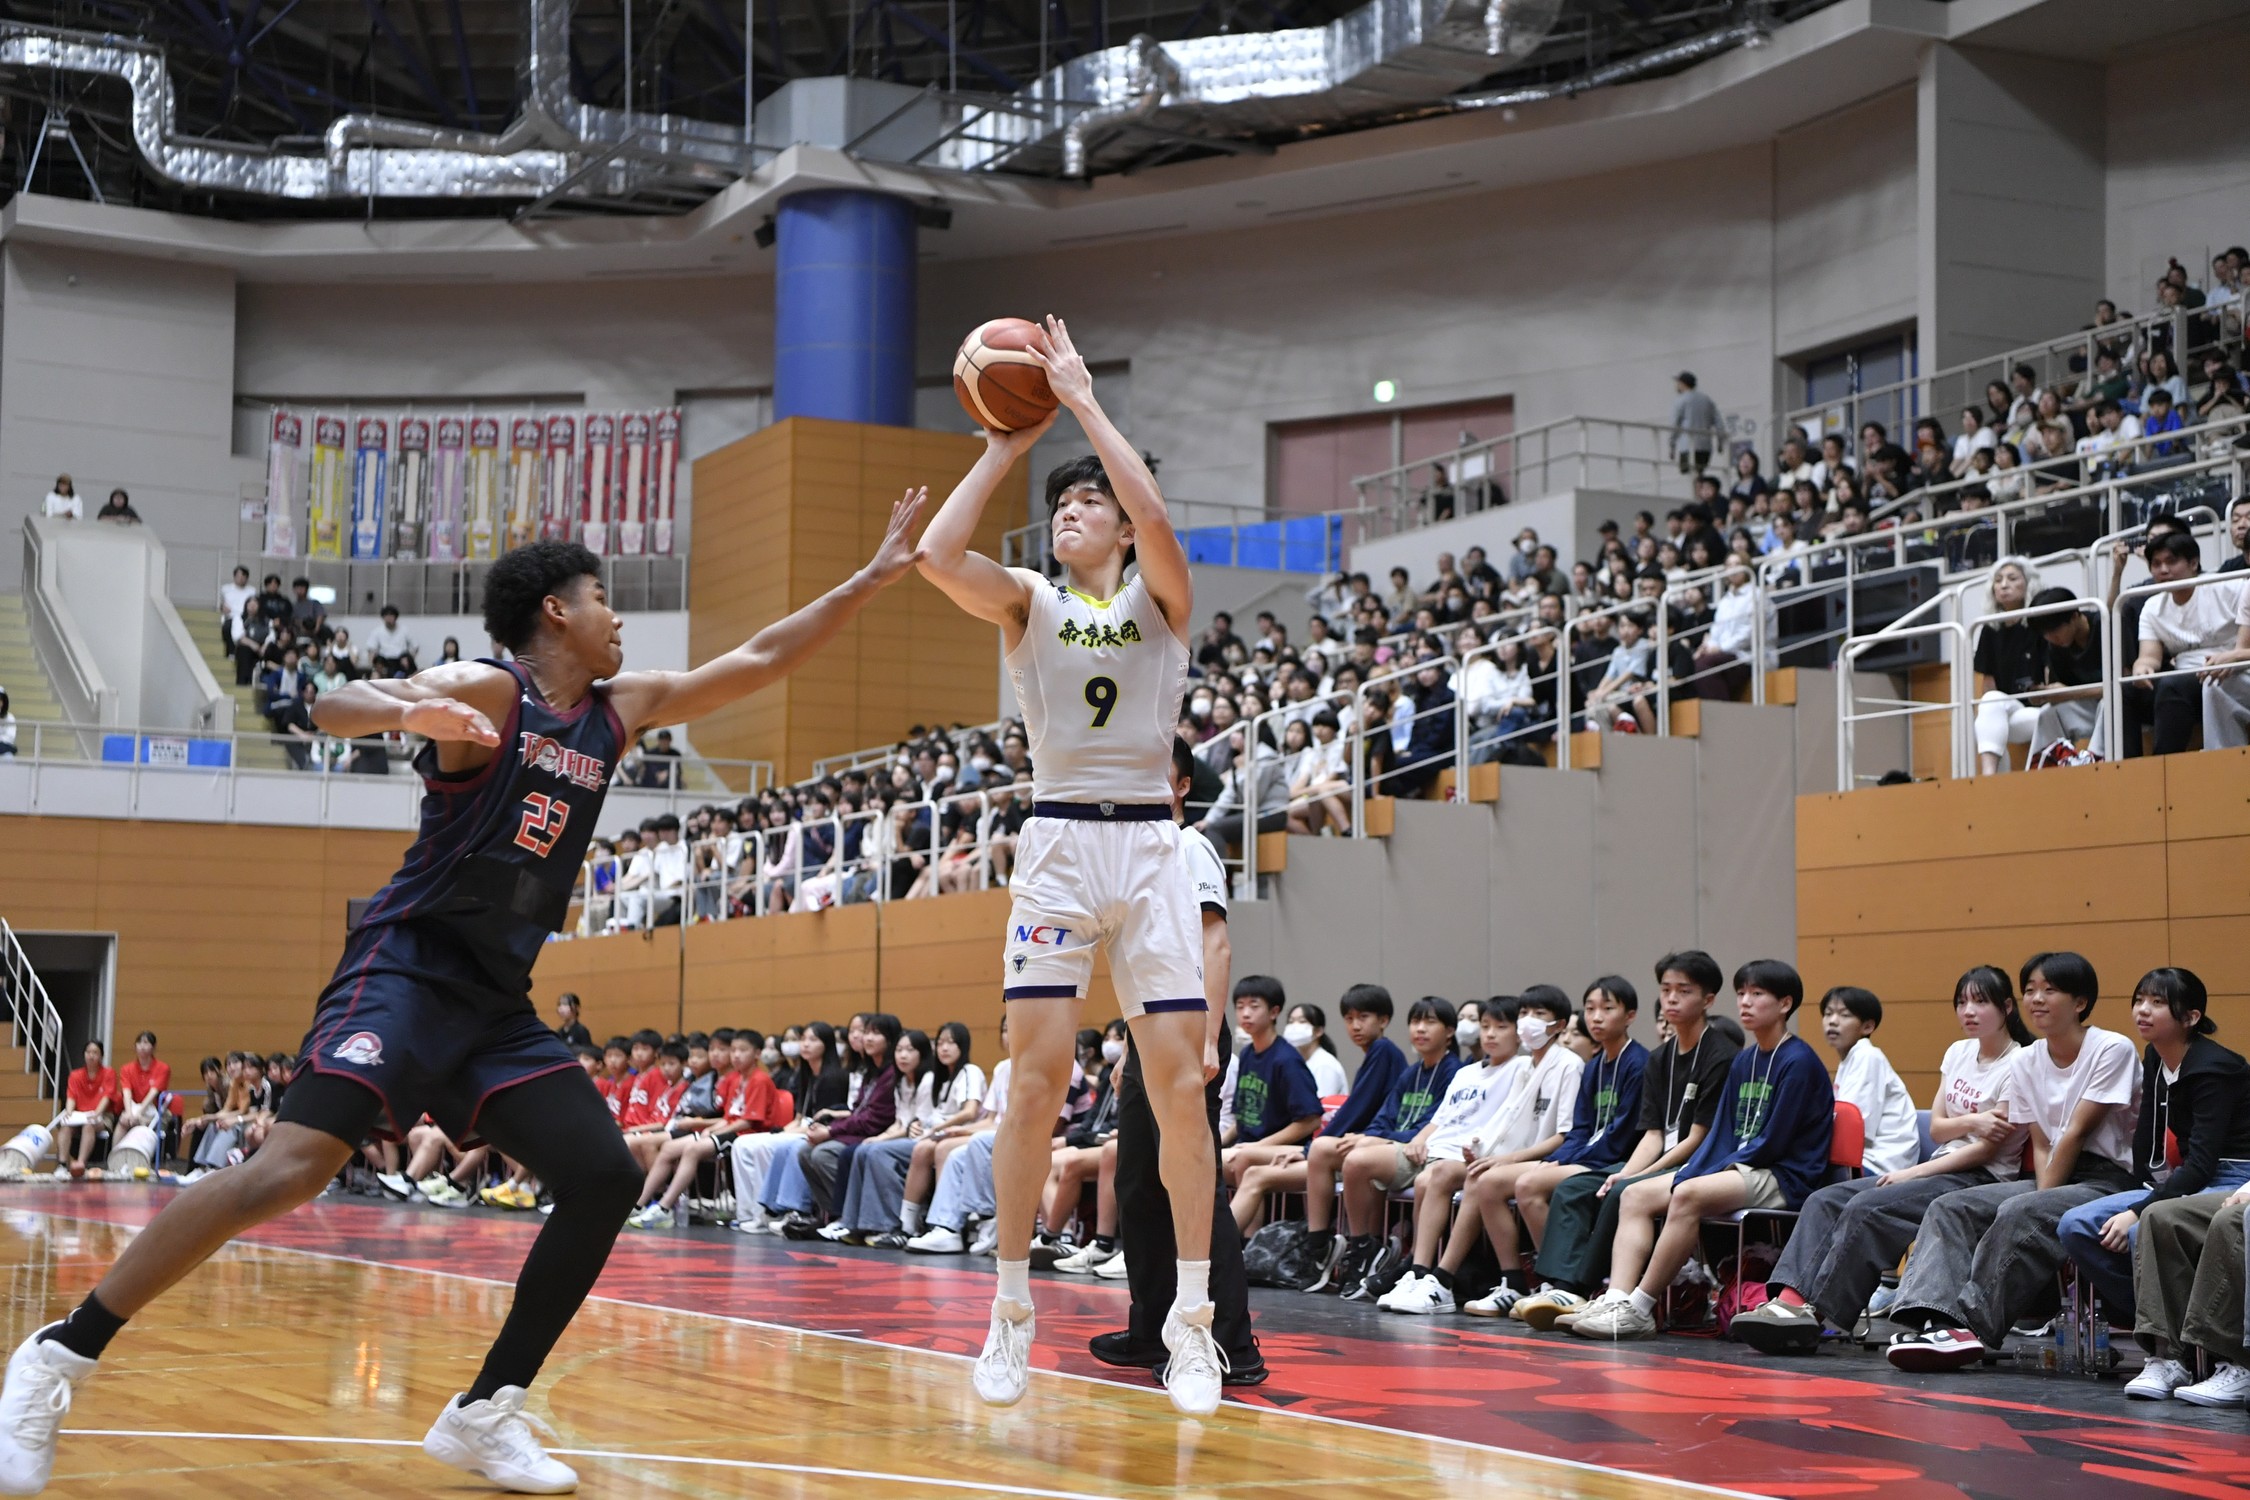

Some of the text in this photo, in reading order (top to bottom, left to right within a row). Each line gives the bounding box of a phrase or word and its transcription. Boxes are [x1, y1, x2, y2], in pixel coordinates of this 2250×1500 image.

[1058, 618, 1141, 648] 帝京長岡
[1084, 675, 1118, 728] 9
[513, 791, 571, 858] 23
[1013, 925, 1072, 946] NCT
[1946, 1092, 1959, 1104] of
[1953, 1078, 1982, 1099] Class
